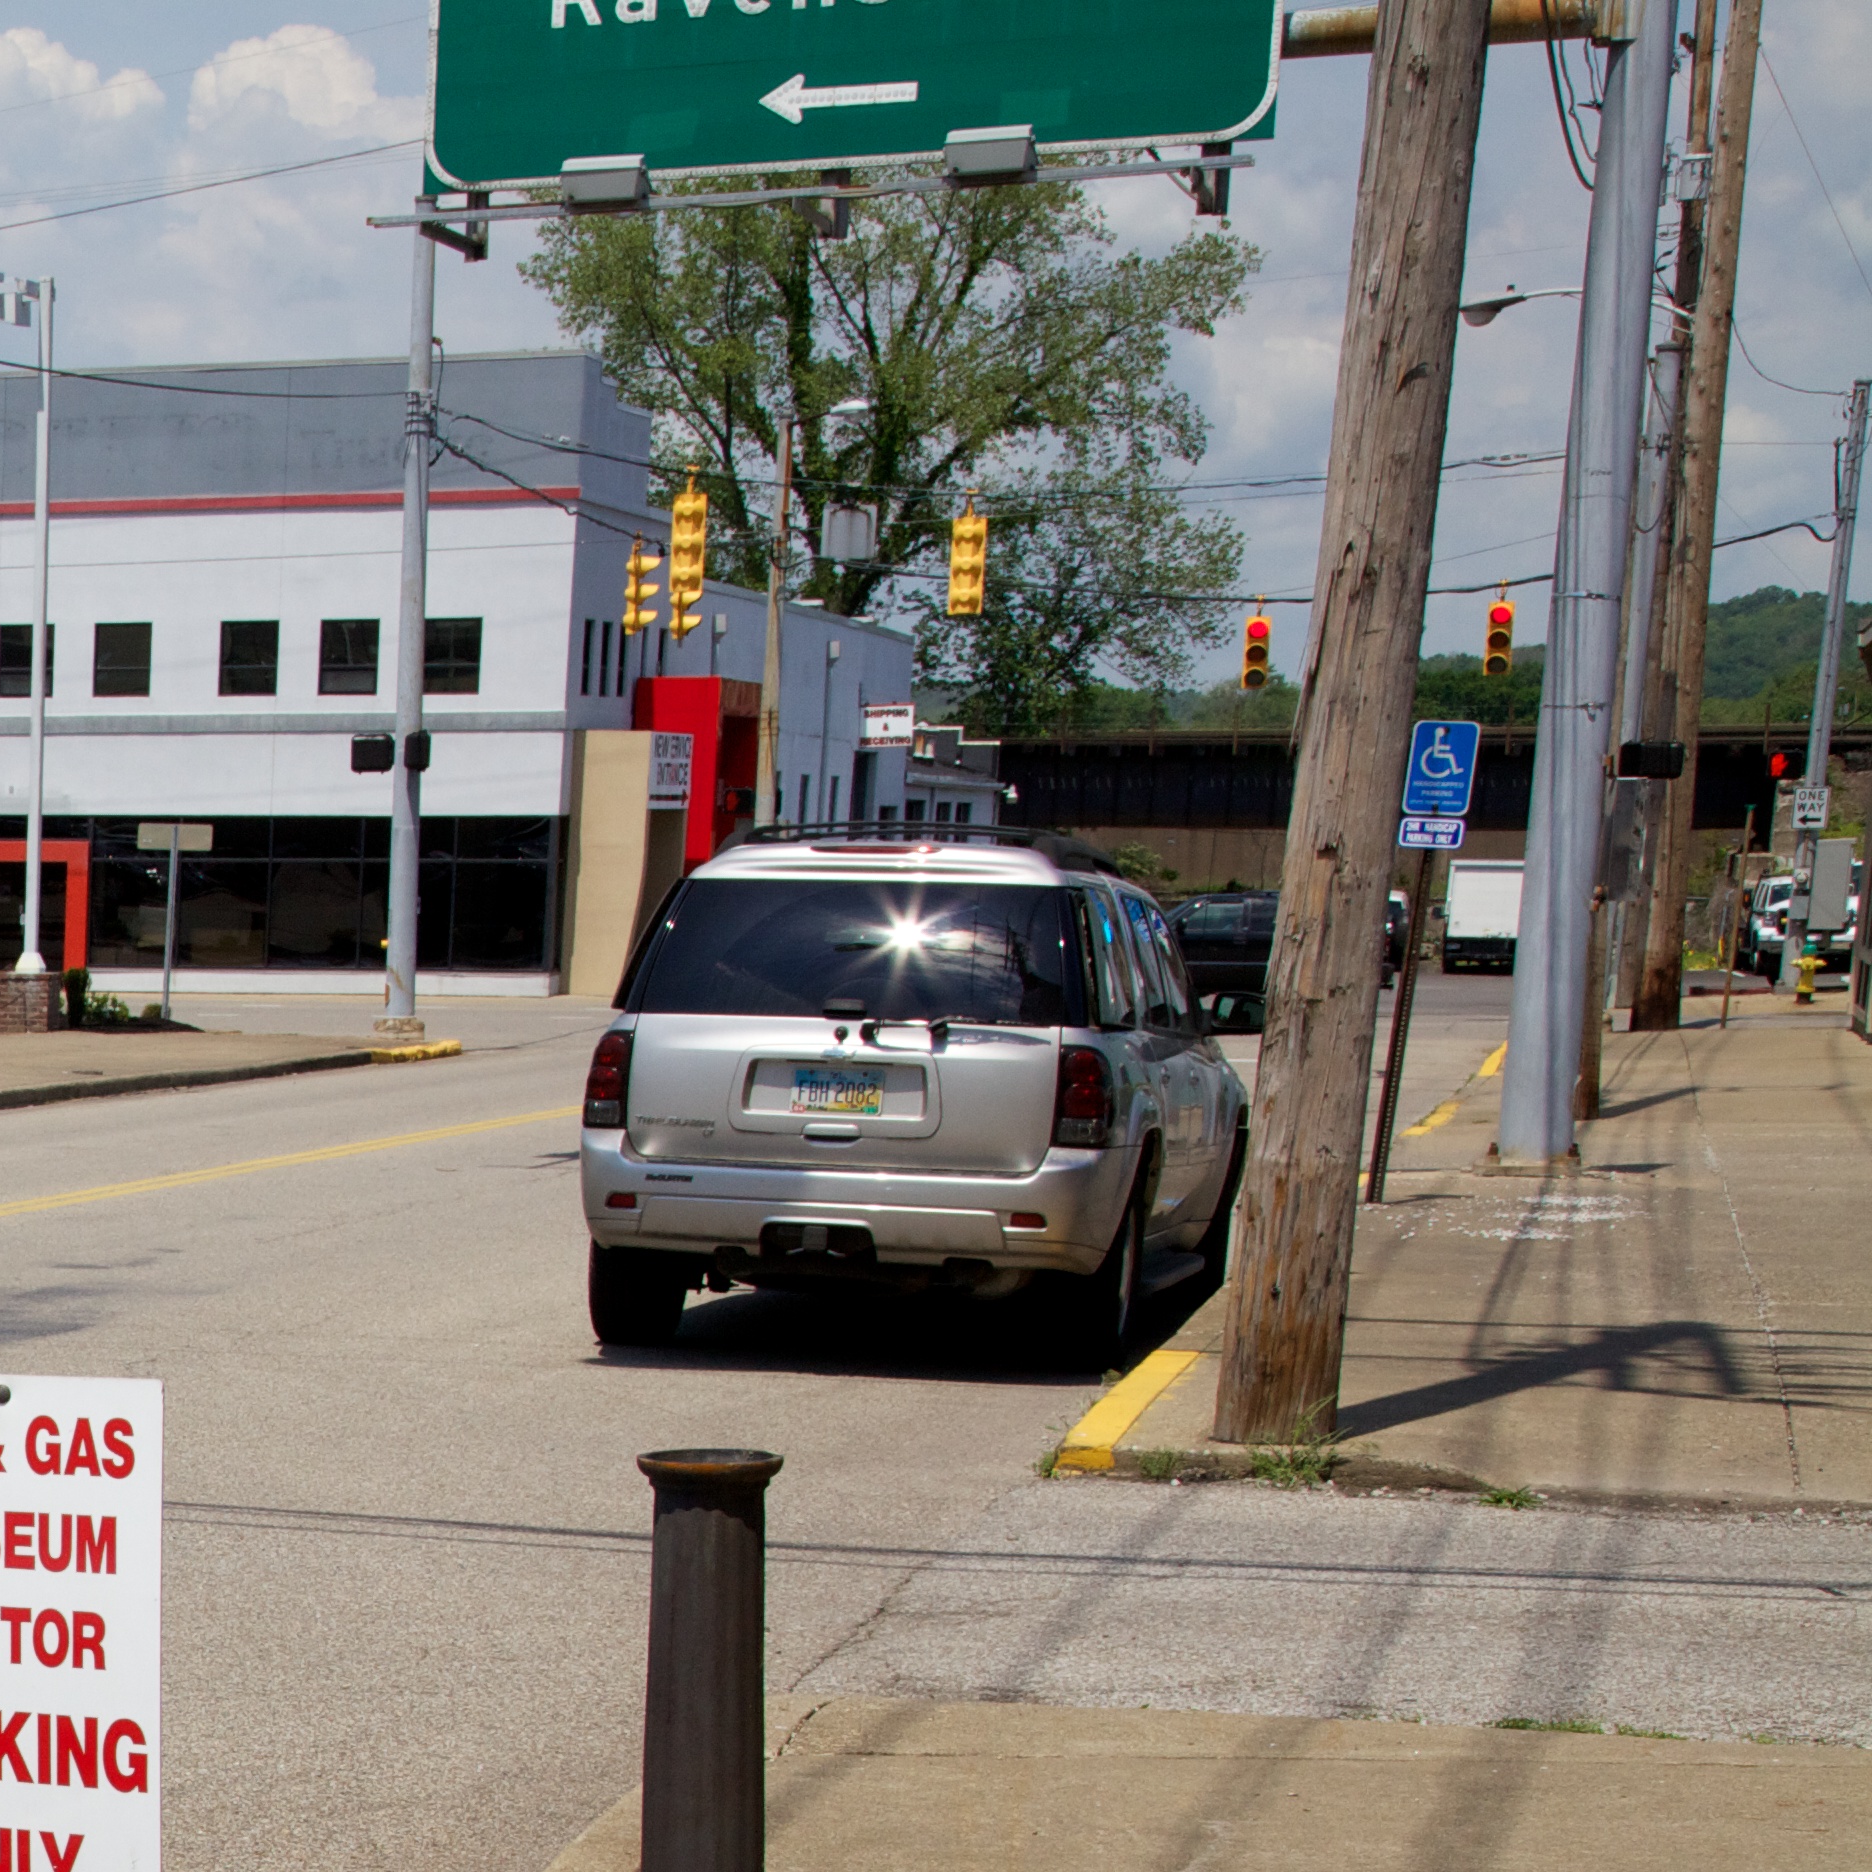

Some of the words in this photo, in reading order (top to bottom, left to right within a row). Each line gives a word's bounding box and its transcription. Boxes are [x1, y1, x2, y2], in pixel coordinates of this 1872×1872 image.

[864, 708, 909, 718] SHIPPING
[1803, 793, 1835, 805] ONE
[1801, 807, 1834, 819] WAY
[25, 1415, 135, 1479] GAS
